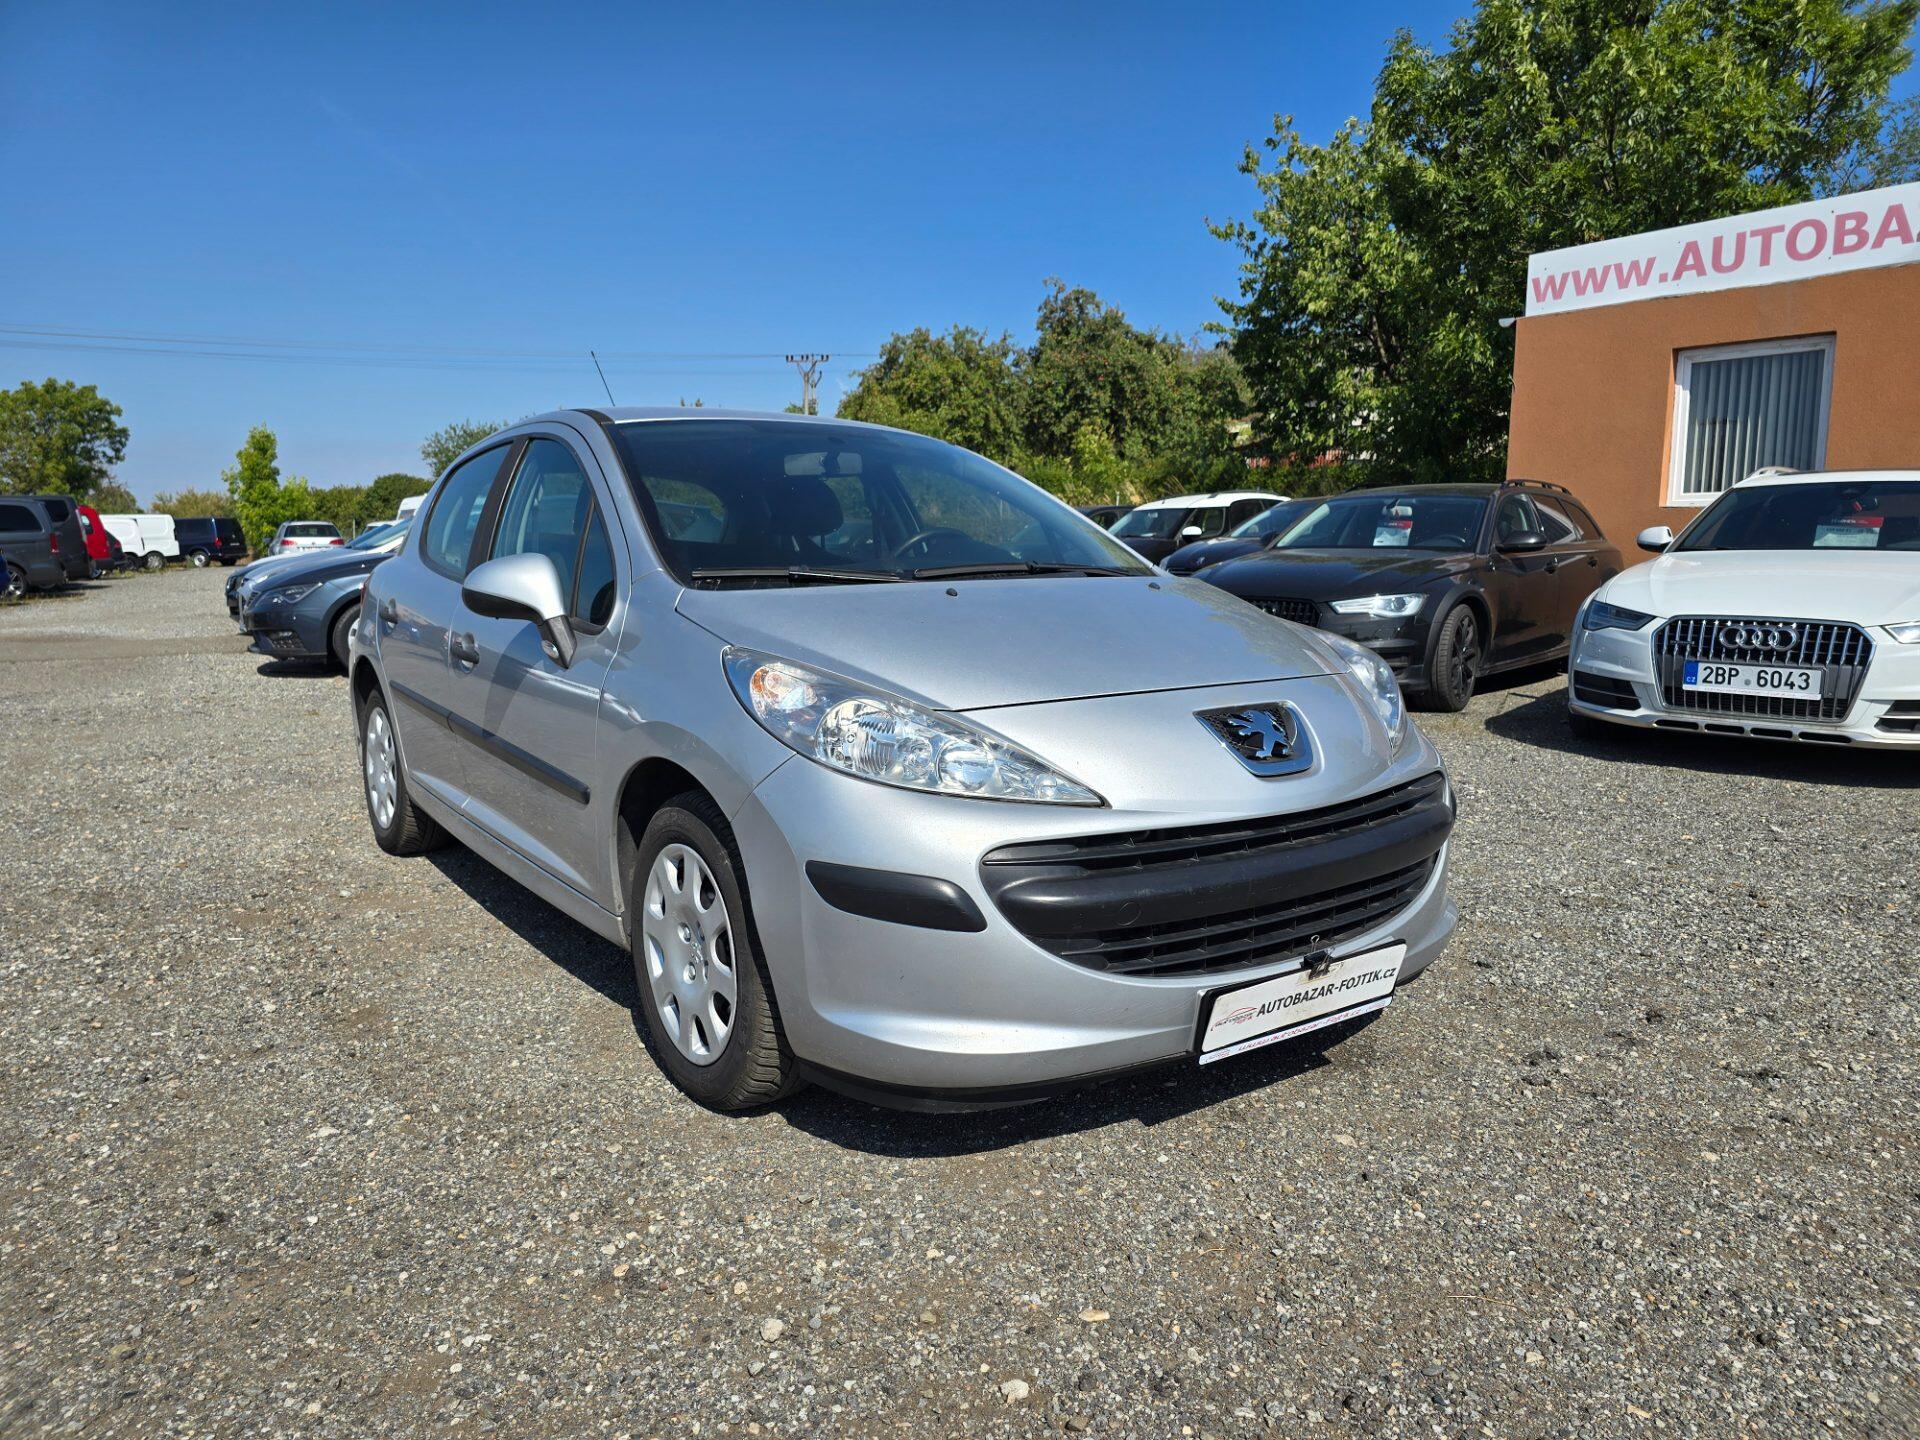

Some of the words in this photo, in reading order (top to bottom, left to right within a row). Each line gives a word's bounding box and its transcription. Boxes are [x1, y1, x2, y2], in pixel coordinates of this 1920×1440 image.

[1531, 203, 1920, 304] www.AUTOBA
[1702, 666, 1740, 685] 2BP
[1756, 669, 1811, 690] 6043
